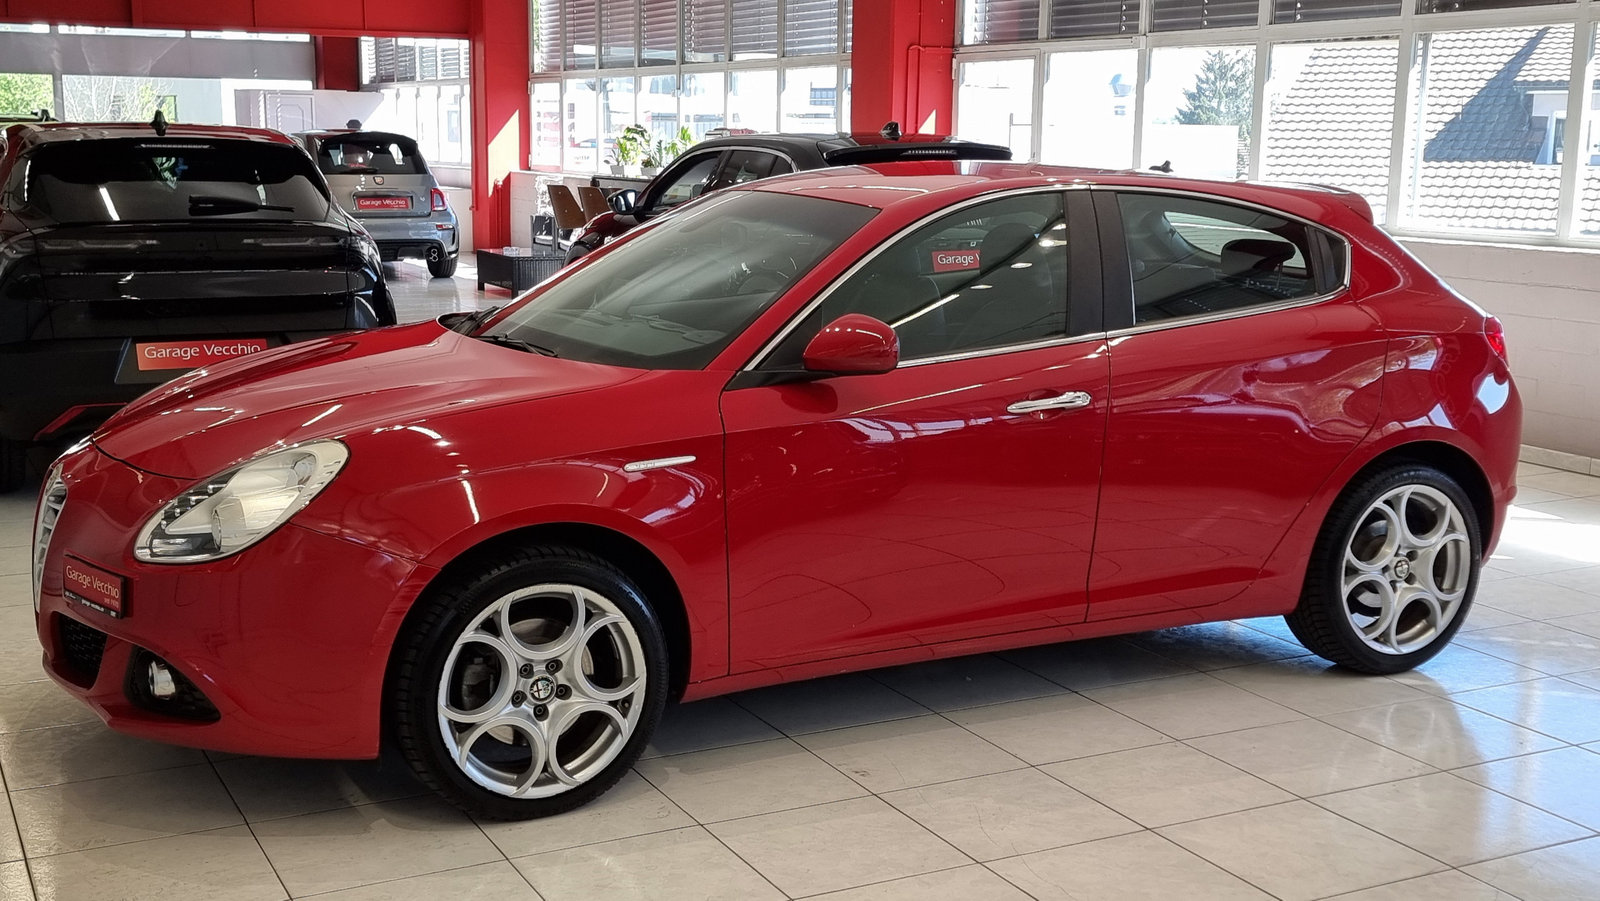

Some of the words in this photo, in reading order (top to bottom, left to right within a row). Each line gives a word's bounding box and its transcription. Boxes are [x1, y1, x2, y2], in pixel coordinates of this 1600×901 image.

[937, 254, 974, 266] Garage
[144, 346, 200, 360] Garage
[203, 343, 261, 356] Vecchio
[66, 565, 91, 589] Garage
[91, 575, 120, 599] Vecchio
